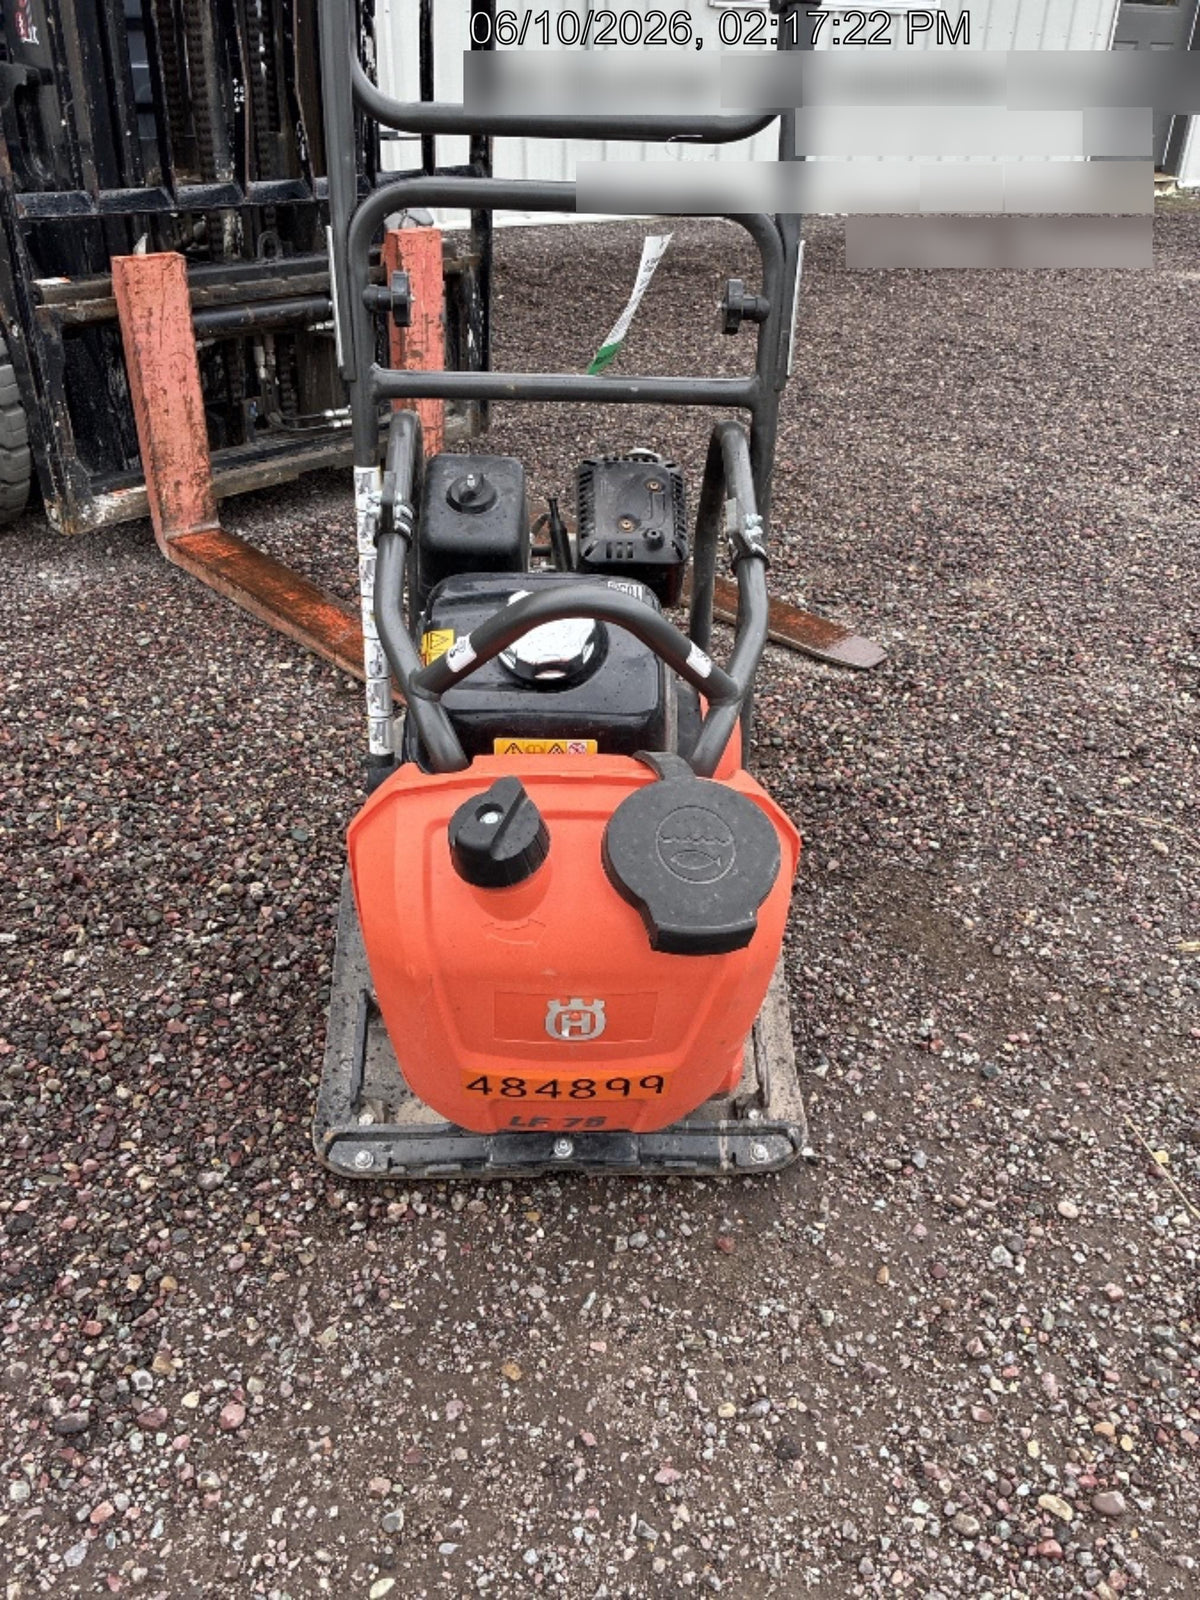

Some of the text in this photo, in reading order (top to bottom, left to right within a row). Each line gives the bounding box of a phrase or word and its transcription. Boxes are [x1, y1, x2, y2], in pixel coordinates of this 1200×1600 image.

[466, 1074, 665, 1100] 484899
[509, 1115, 608, 1128] LF 75
